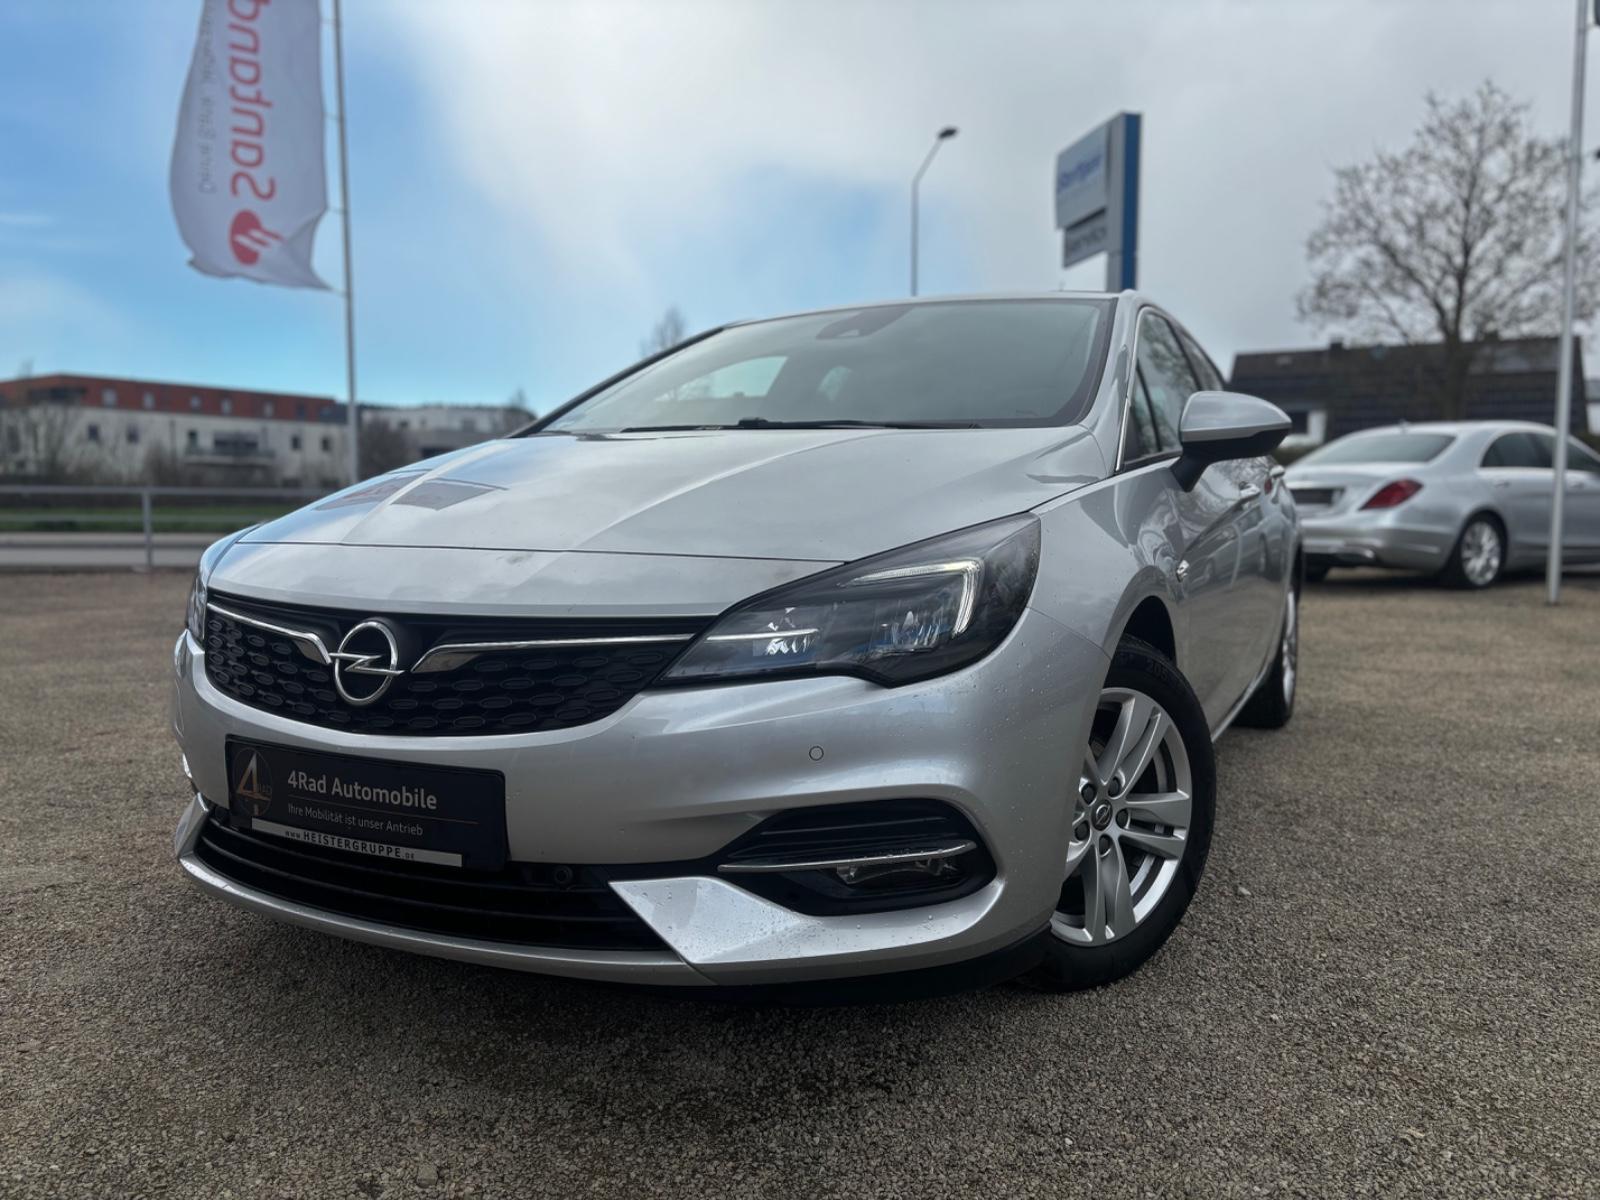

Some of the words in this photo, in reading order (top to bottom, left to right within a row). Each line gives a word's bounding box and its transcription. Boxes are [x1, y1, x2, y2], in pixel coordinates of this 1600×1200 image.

[287, 770, 328, 795] 4Rad
[331, 776, 438, 810] Automobile
[288, 803, 304, 817] Ihre
[304, 806, 344, 825] Mobilität
[344, 813, 356, 826] ist
[358, 818, 384, 830] unser
[386, 819, 424, 837] Antrieb
